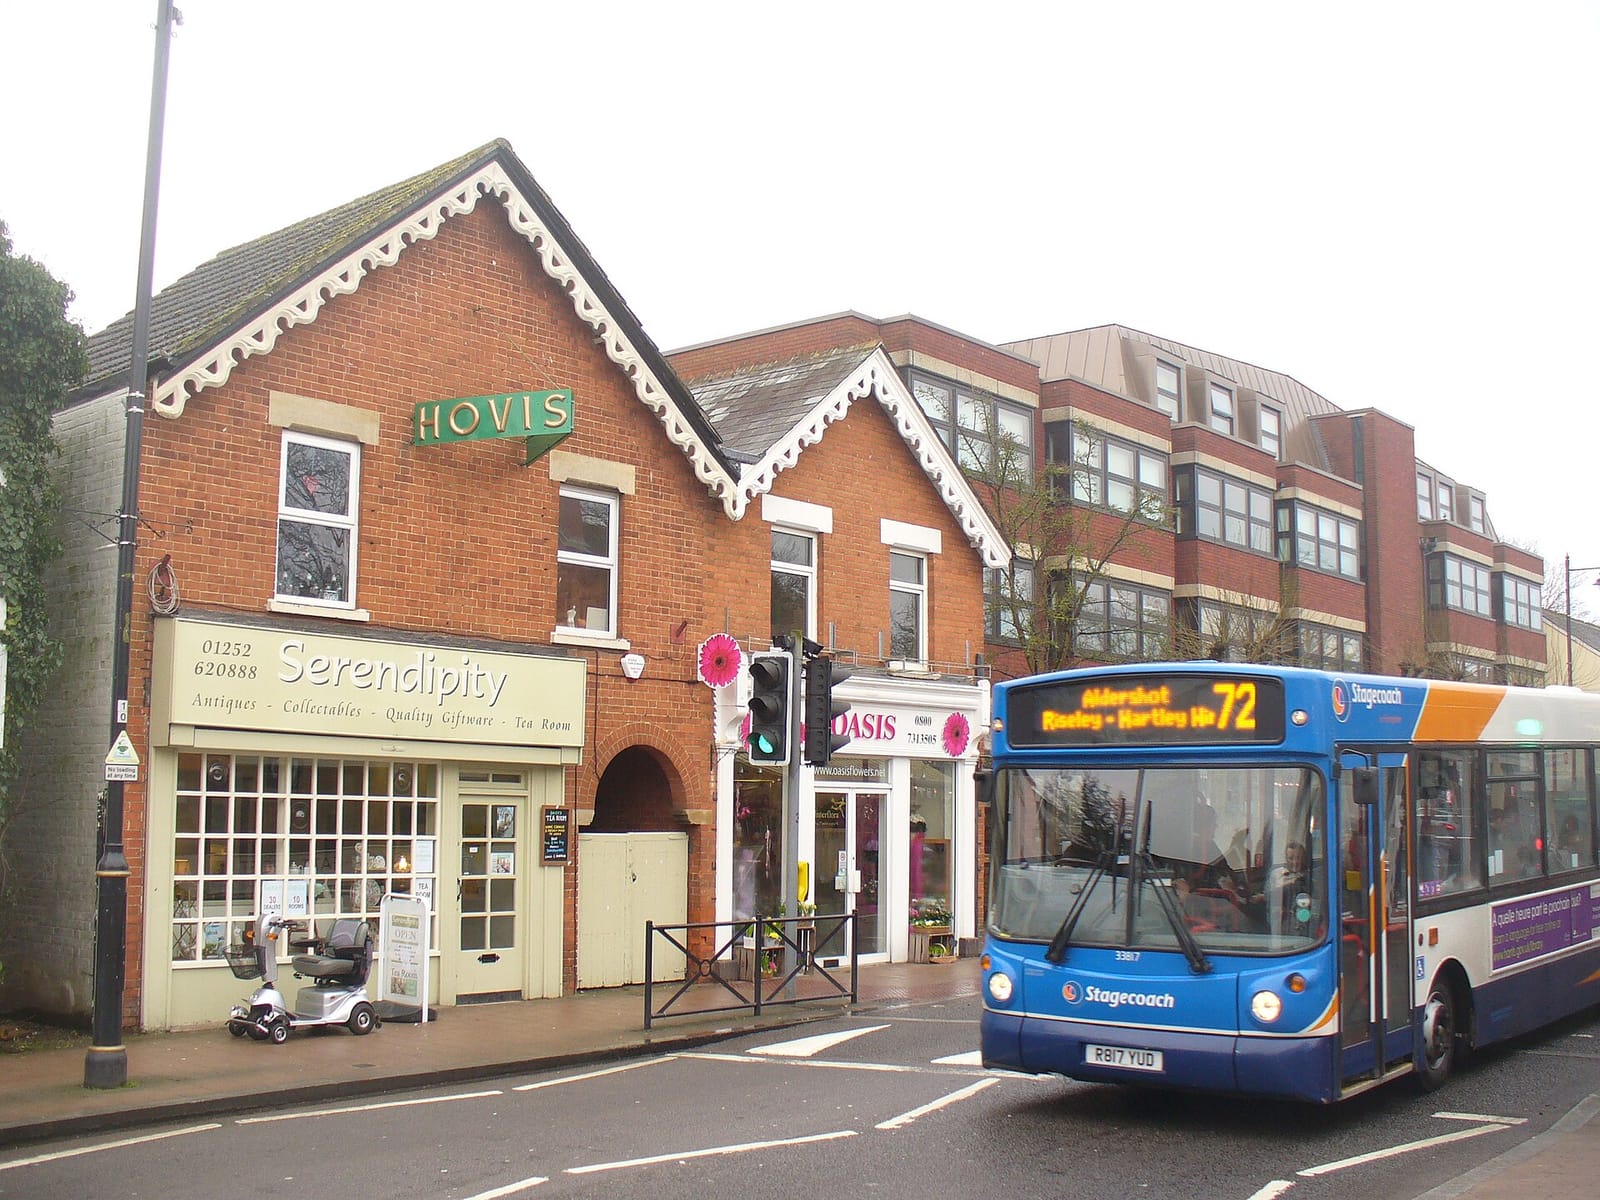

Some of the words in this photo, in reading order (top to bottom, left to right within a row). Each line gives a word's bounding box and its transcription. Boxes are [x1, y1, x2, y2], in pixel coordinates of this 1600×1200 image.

[419, 393, 567, 441] HOVIS
[202, 639, 252, 657] 01252
[194, 661, 258, 680] 620888
[278, 639, 507, 706] Serendipity
[1082, 685, 1170, 709] Aldershot
[1351, 683, 1402, 709] Stagecoach
[192, 692, 257, 715] Antiques
[283, 698, 361, 718] Collectables
[386, 706, 433, 727] Quality
[442, 710, 494, 729] Giftware
[515, 716, 533, 729] Tea
[541, 718, 571, 731] Room
[1213, 683, 1256, 731] 72
[831, 713, 896, 740] OASIS
[915, 715, 932, 727] 0800
[1042, 710, 1102, 731] Riseley
[1118, 707, 1188, 729] Hartley
[908, 732, 937, 745] 7313505
[814, 765, 886, 778] www.oasisflowers.net
[418, 882, 429, 890] TEA
[293, 896, 301, 904] 10
[394, 927, 417, 940] OPEN
[1115, 951, 1140, 962] 33817
[401, 968, 418, 979] Room
[1085, 986, 1175, 1008] Stagecoach
[1095, 1047, 1124, 1064] R817
[1128, 1050, 1154, 1067] YUD
